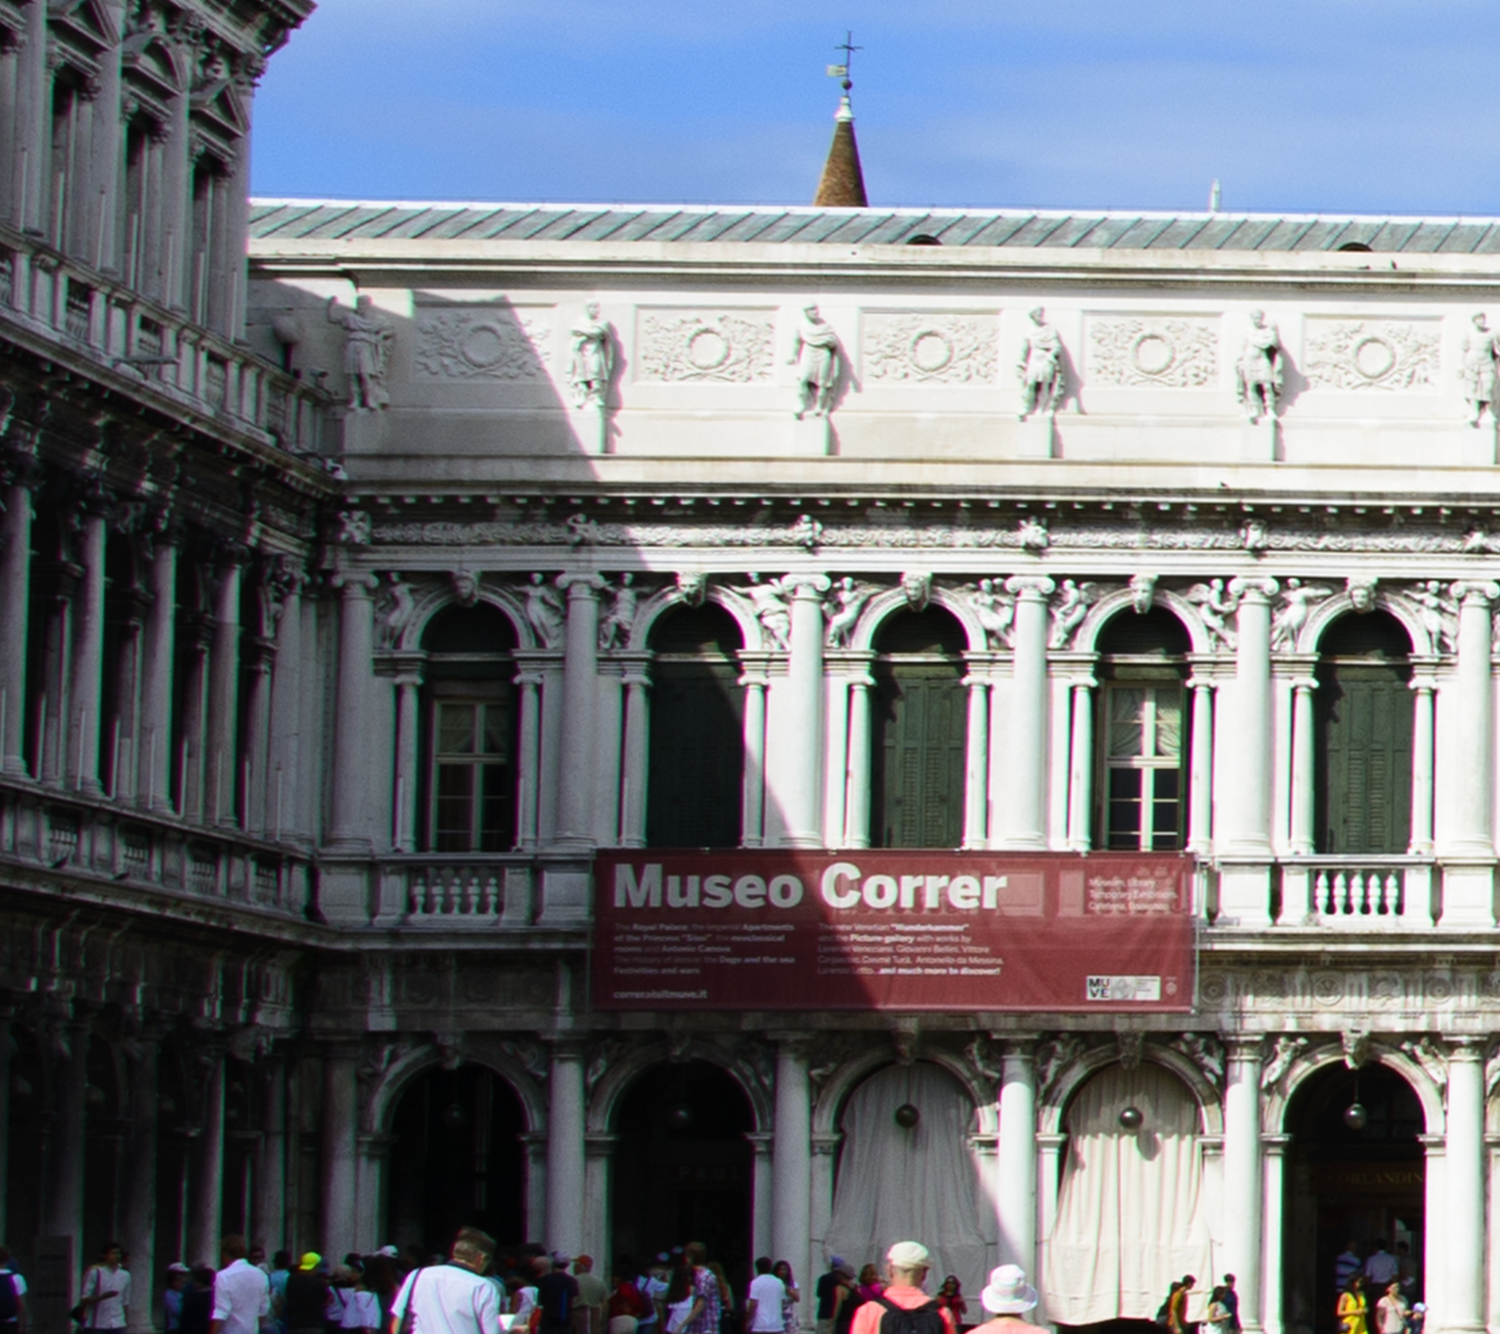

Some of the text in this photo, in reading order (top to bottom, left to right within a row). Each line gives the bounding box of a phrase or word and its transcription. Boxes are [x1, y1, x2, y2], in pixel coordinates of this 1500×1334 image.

[613, 861, 1007, 910] Museo Correr
[1088, 977, 1110, 988] MU
[1090, 988, 1110, 999] VE
